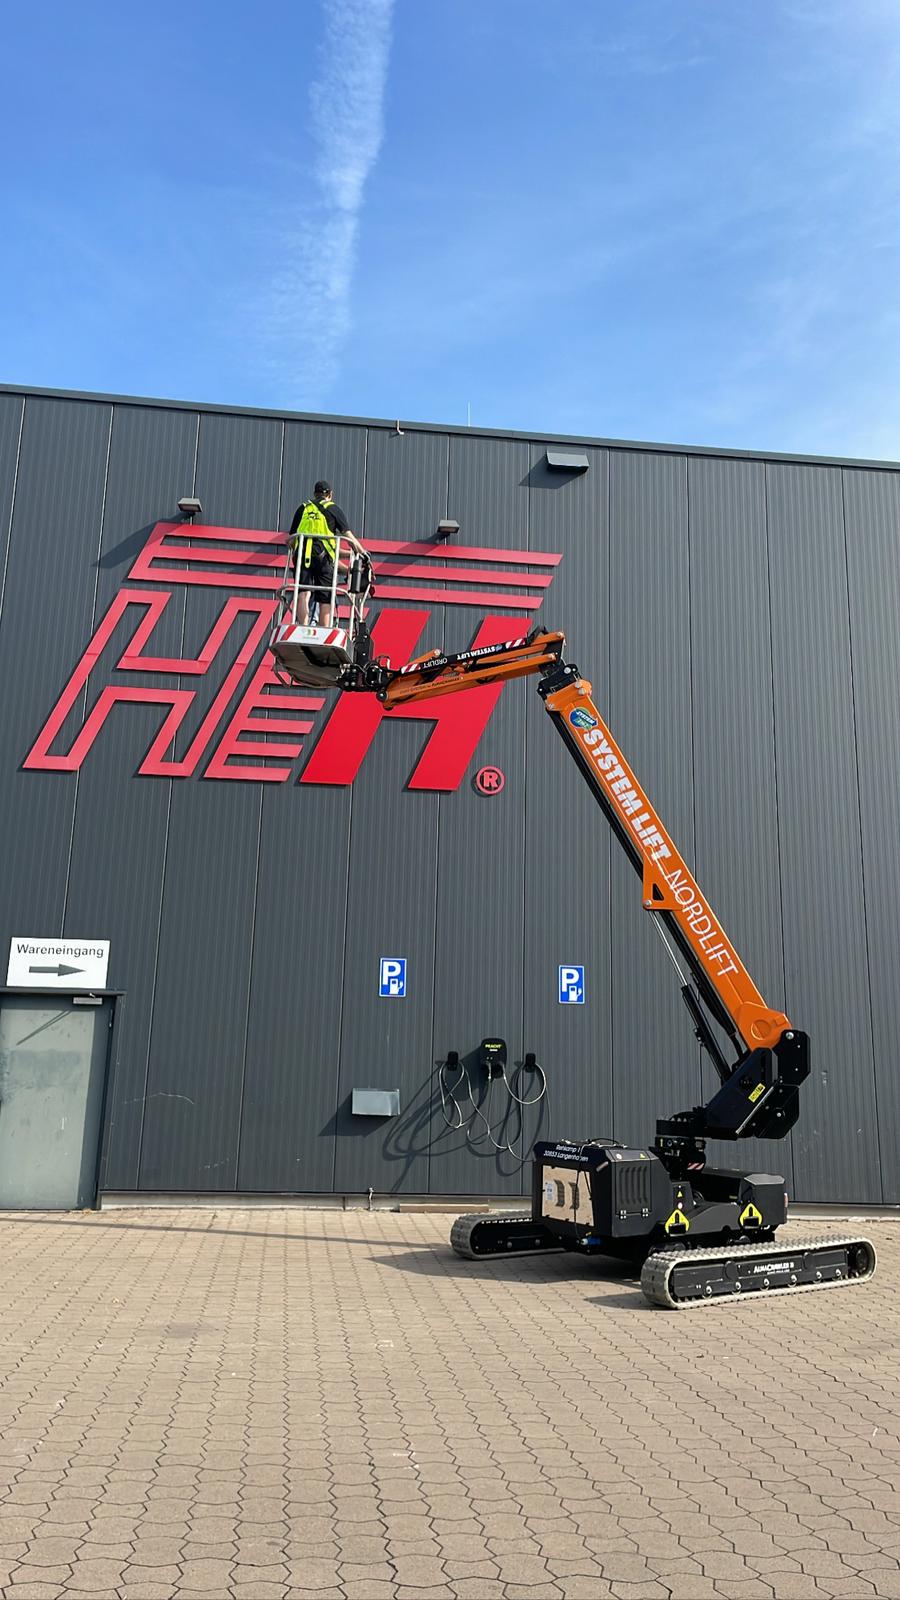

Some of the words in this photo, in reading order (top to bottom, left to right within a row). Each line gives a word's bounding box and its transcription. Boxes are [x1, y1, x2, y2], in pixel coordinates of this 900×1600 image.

[583, 728, 643, 816] SYSTEM
[631, 812, 672, 861] LIFT
[665, 868, 739, 977] NORDLIFT
[17, 944, 104, 959] Wareneingang
[382, 961, 401, 986] P
[561, 969, 580, 992] P
